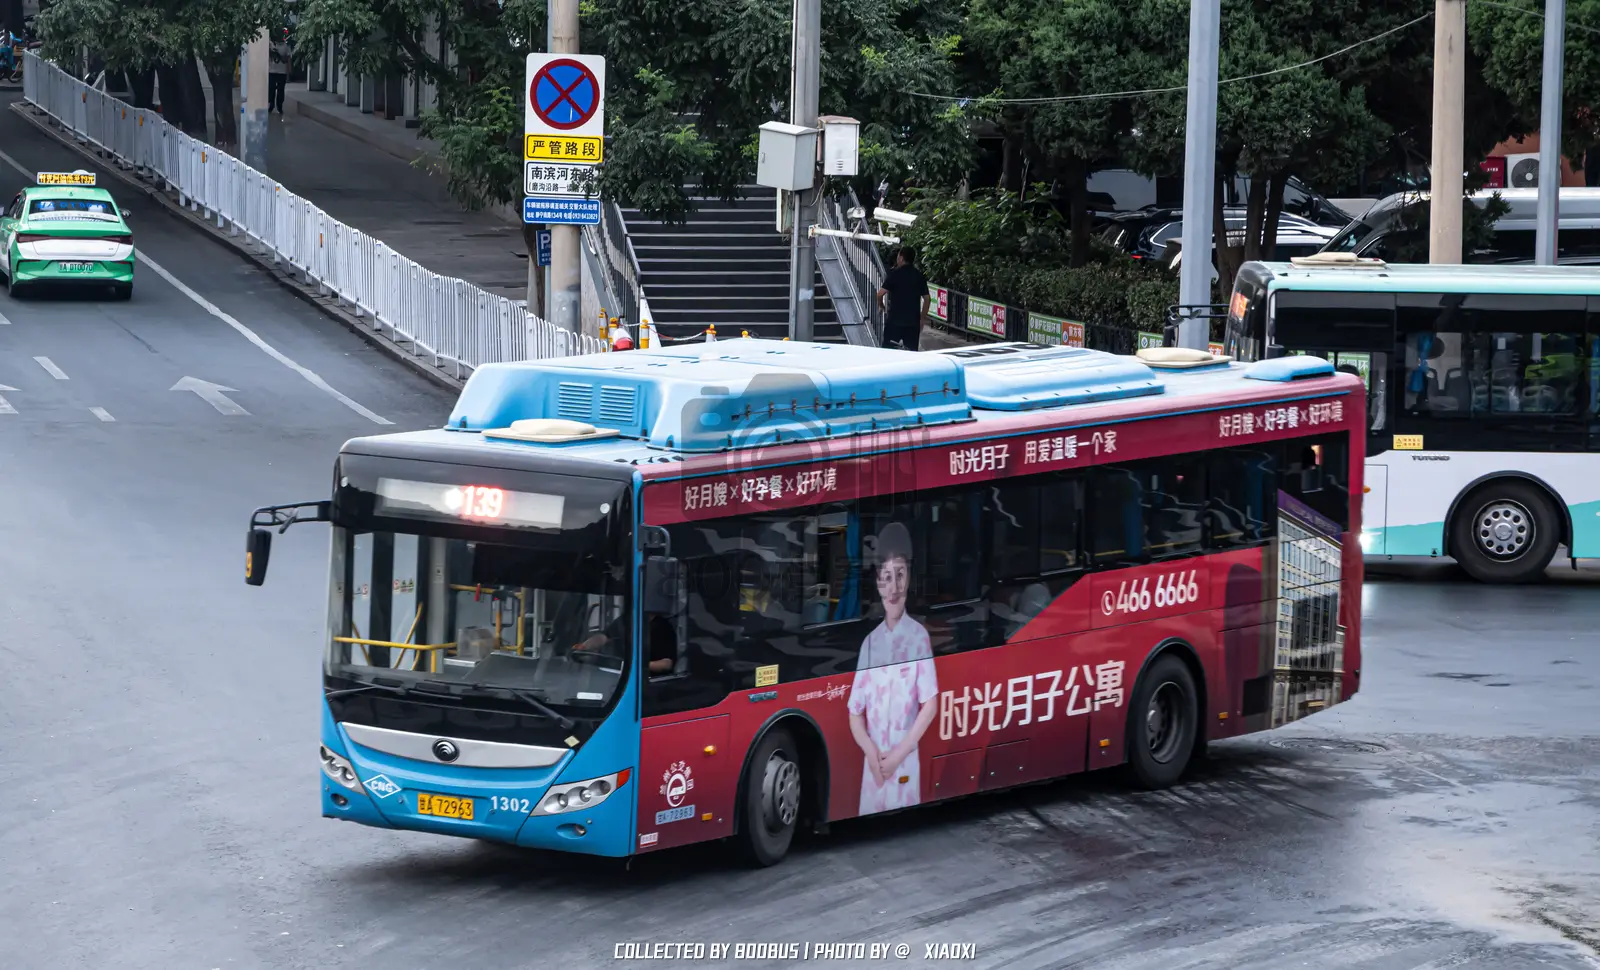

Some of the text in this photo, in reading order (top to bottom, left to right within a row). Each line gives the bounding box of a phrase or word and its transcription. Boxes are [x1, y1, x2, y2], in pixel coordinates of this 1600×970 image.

[532, 140, 596, 156] 严管路段
[531, 166, 594, 180] 南滨河东路
[541, 233, 551, 250] P
[950, 430, 1117, 475] 时光月子 用爱温暖一个家
[464, 485, 503, 518] 139
[1116, 570, 1198, 613] 466 6666
[939, 660, 1126, 741] 时光月子公寓
[371, 781, 393, 792] CNG
[490, 796, 530, 813] 1302
